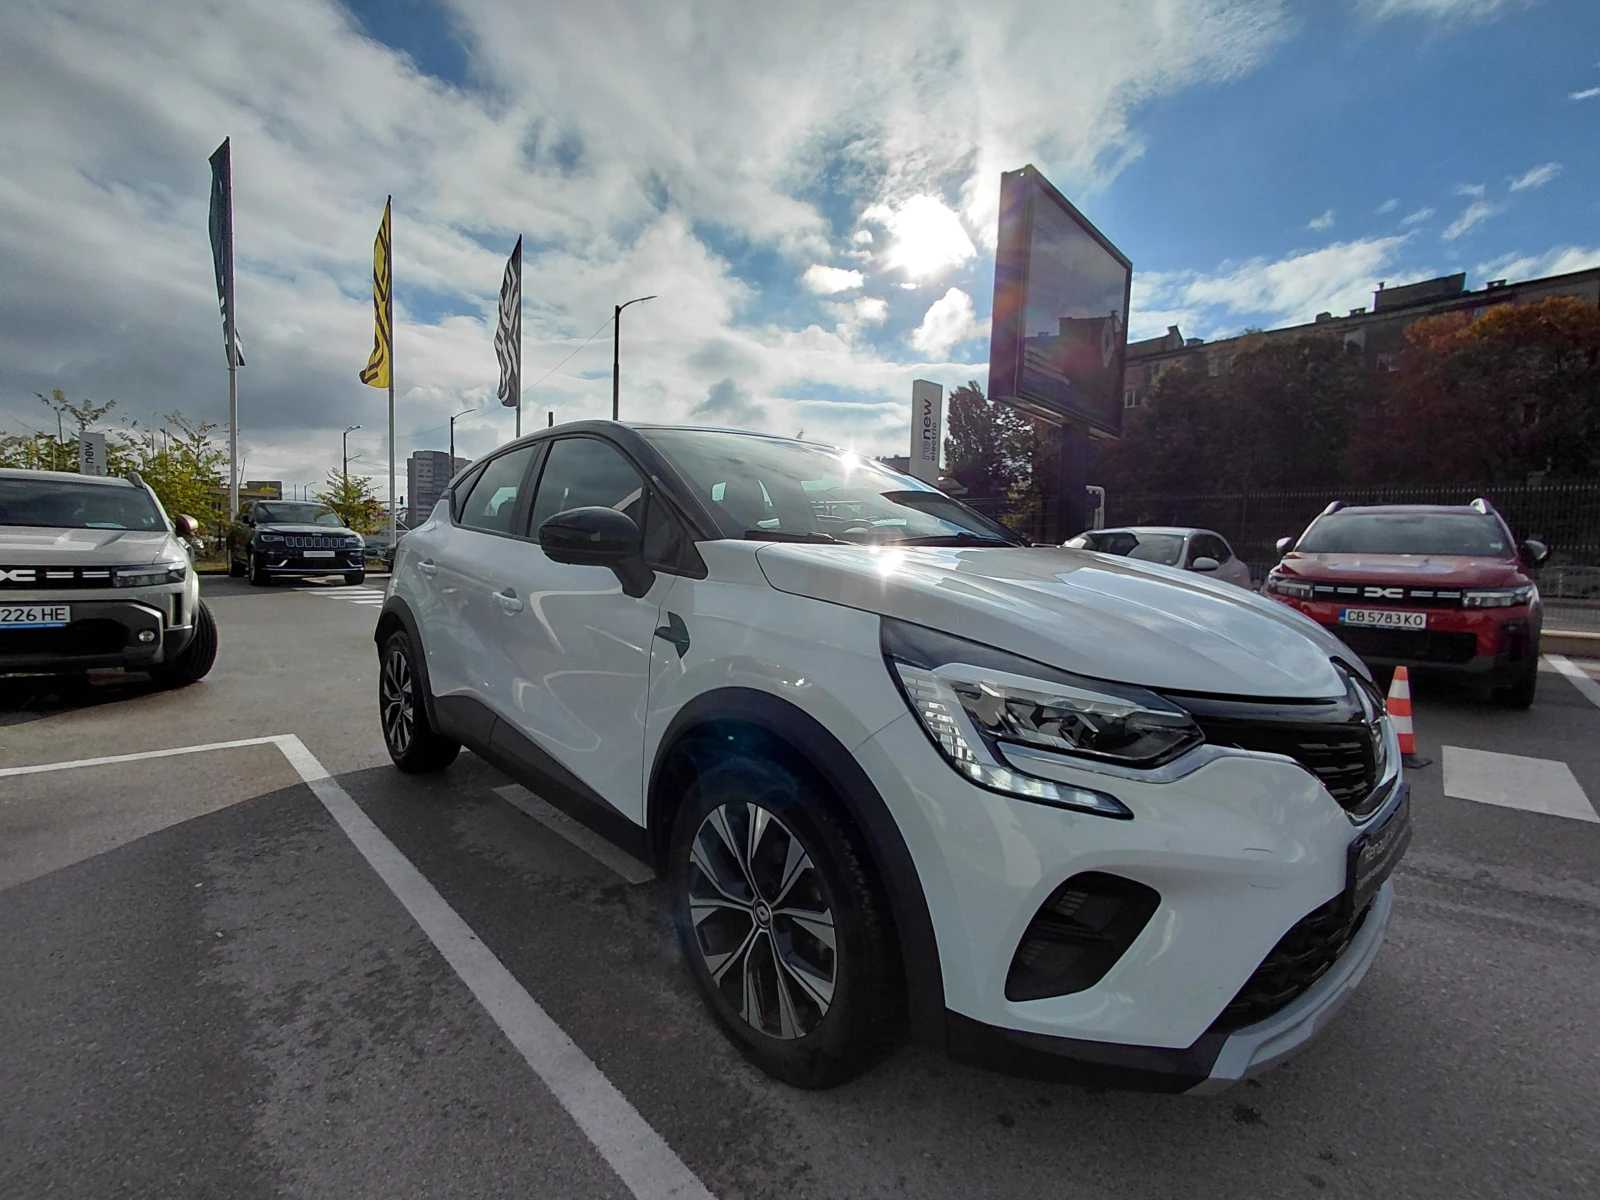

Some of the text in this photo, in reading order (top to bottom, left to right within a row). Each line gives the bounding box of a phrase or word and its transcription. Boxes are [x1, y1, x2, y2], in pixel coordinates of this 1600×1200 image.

[922, 398, 932, 460] renew
[41, 607, 67, 621] HE
[1347, 610, 1423, 626] CB 5783 KO
